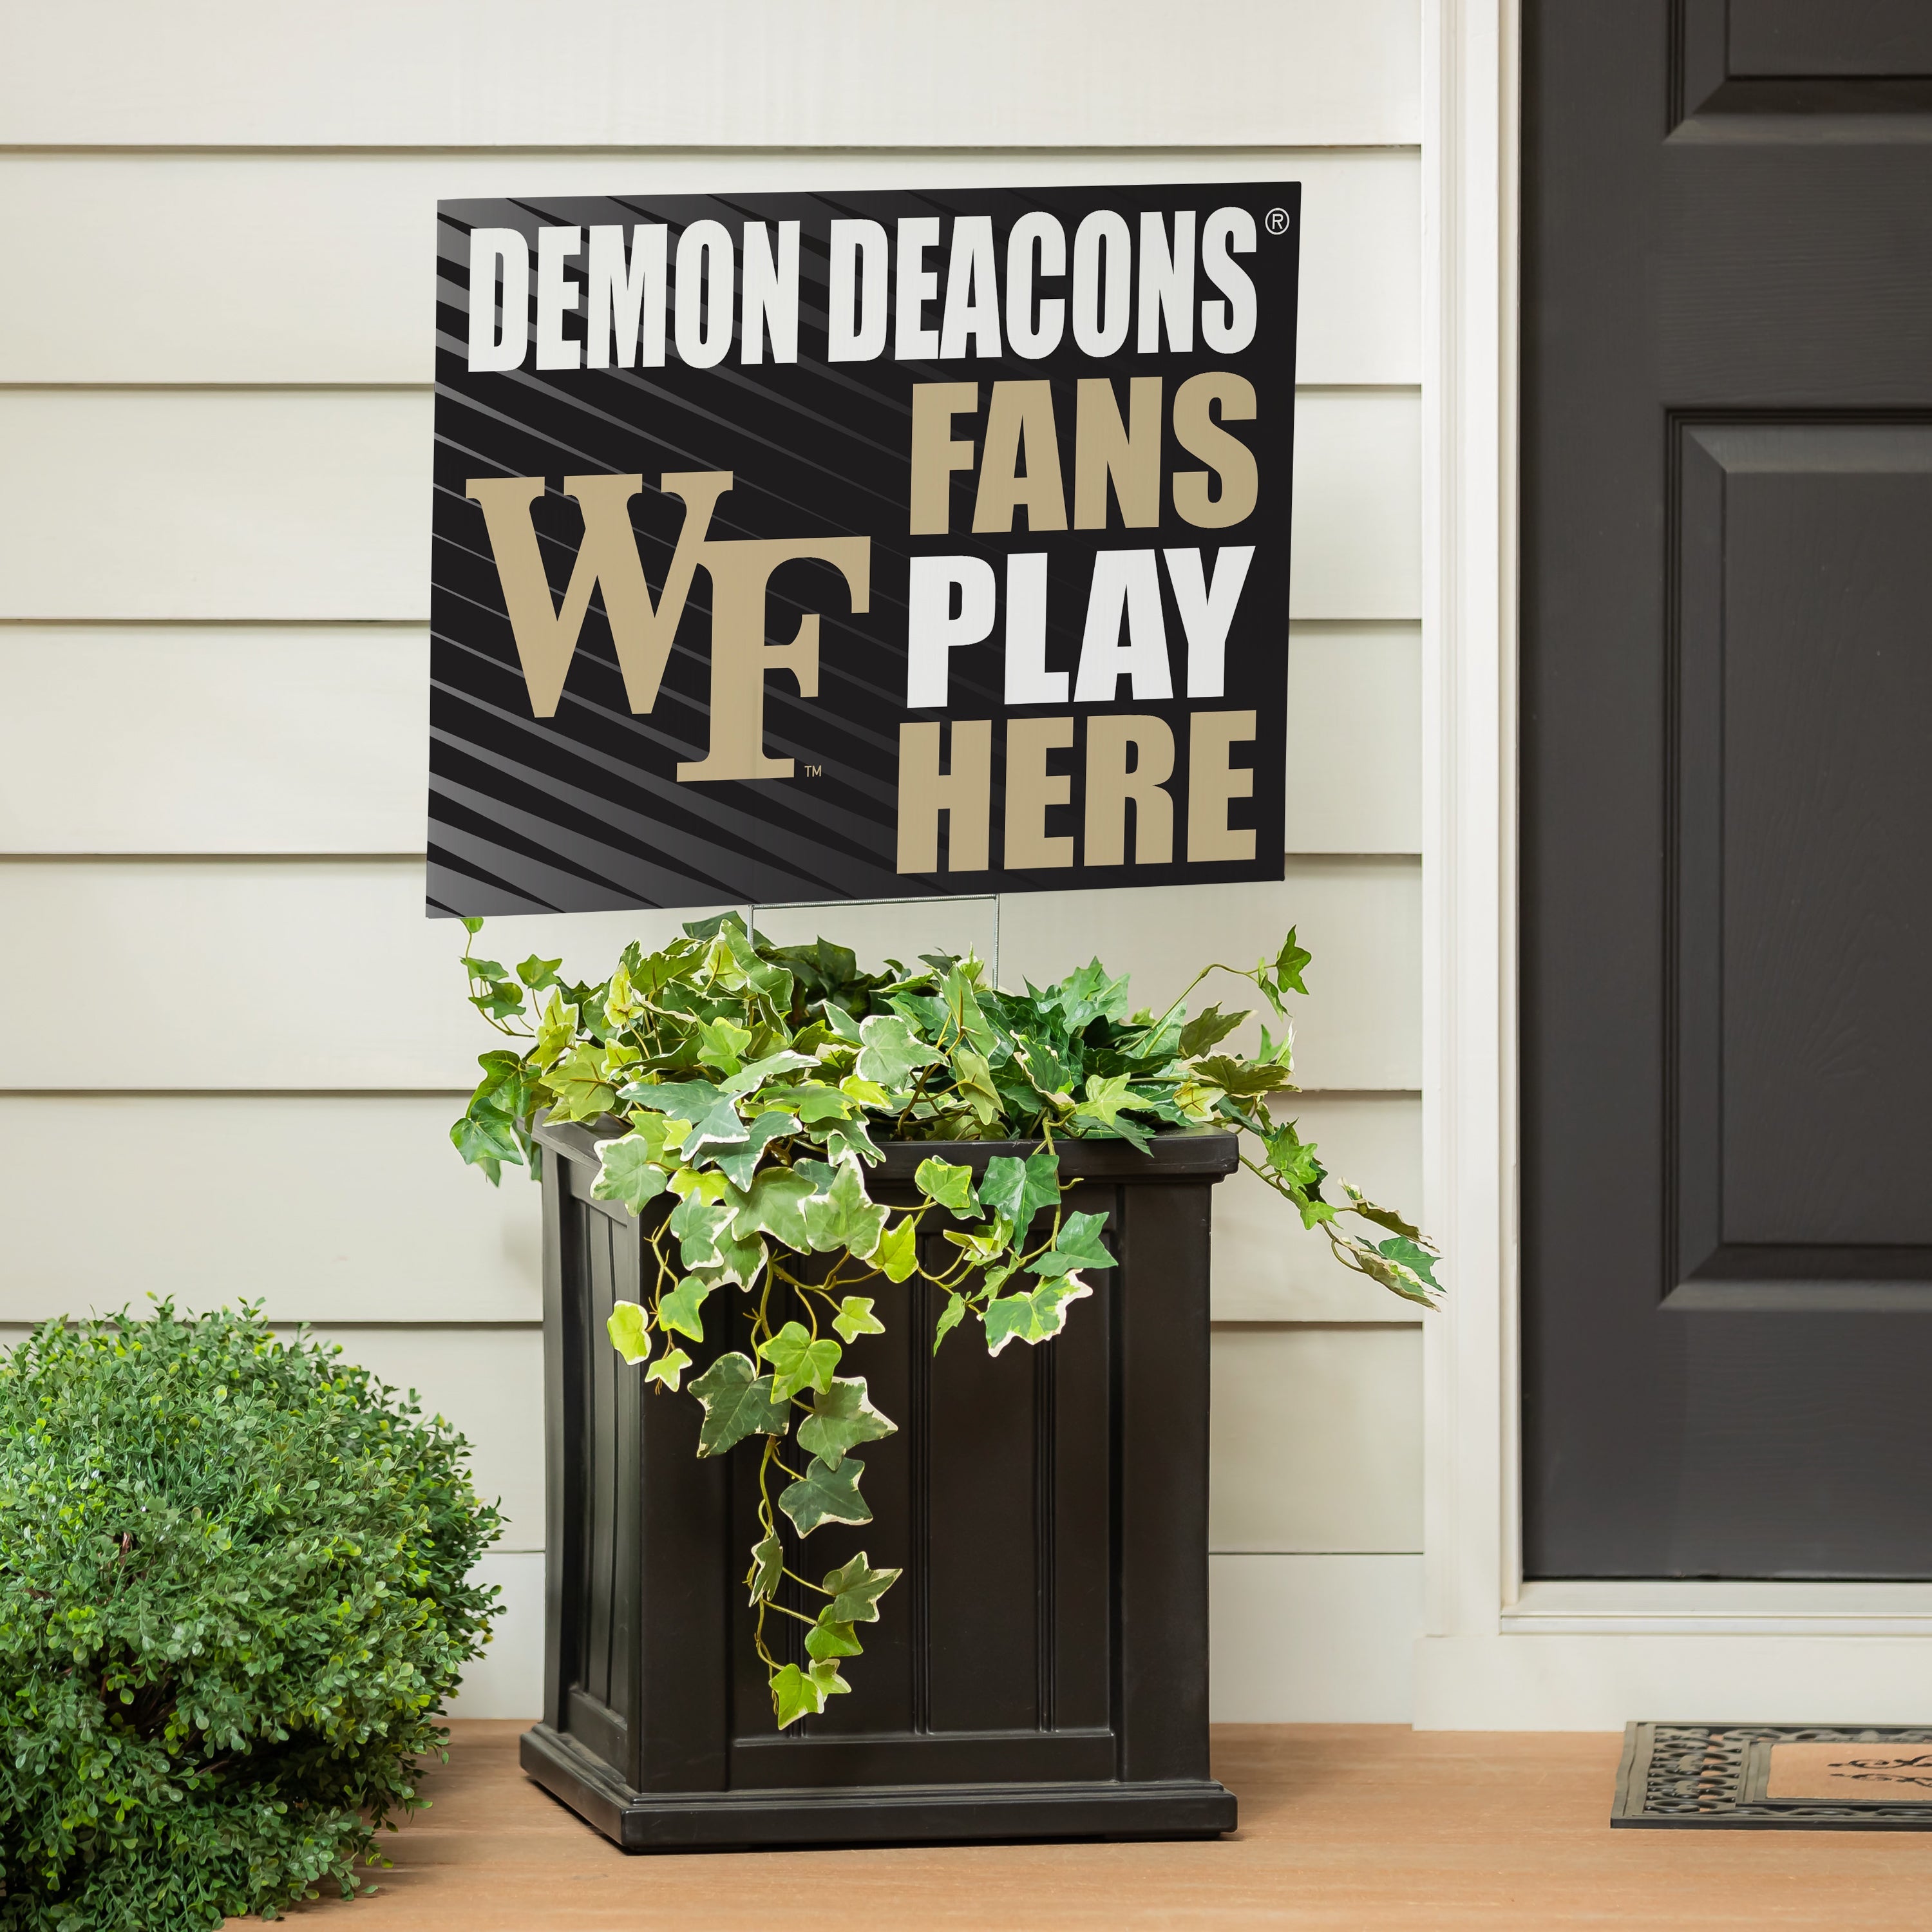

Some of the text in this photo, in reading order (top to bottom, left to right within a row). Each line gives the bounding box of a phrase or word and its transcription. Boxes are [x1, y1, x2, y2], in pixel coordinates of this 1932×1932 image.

[468, 219, 800, 372] DEMON
[828, 207, 1257, 363] DEACONS
[909, 372, 1258, 535] FANS
[466, 471, 871, 782] WF
[907, 545, 1256, 708] PLAY
[896, 710, 1256, 874] HERE
